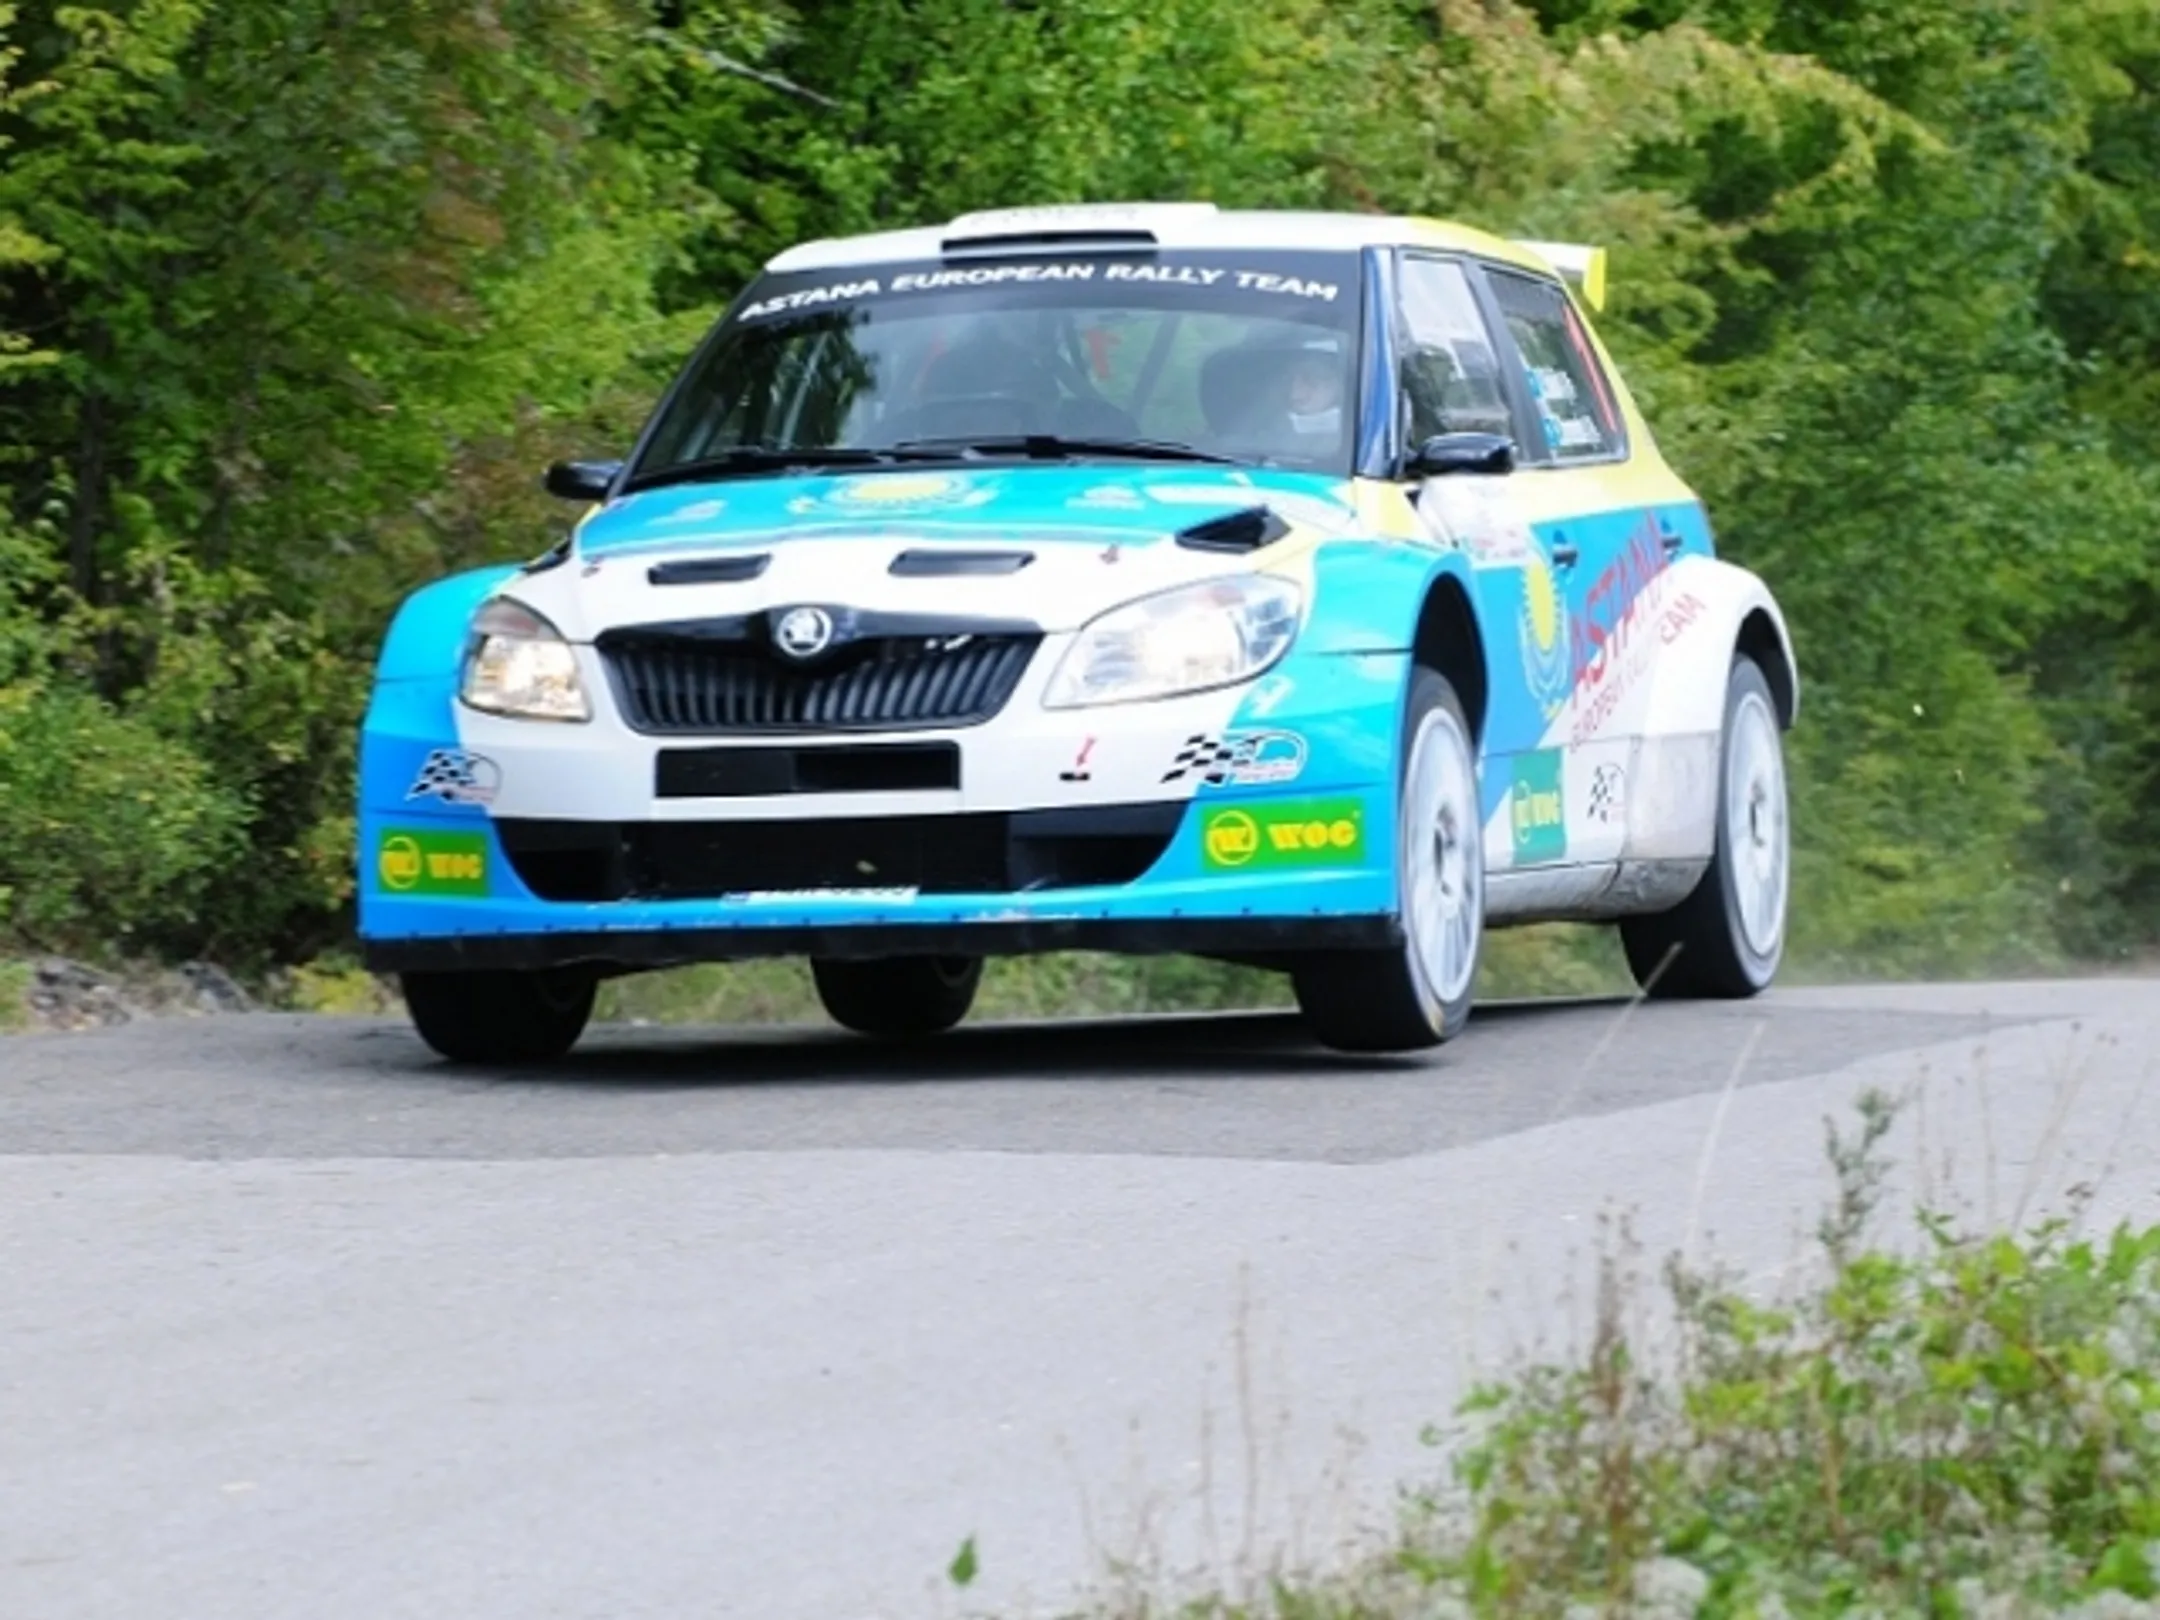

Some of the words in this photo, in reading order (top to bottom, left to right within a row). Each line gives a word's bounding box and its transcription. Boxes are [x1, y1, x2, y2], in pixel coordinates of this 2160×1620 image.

[737, 279, 880, 322] ASTANA
[890, 265, 1094, 291] EUROPEAN
[1104, 264, 1225, 284] RALLY
[1234, 270, 1339, 301] TEAM
